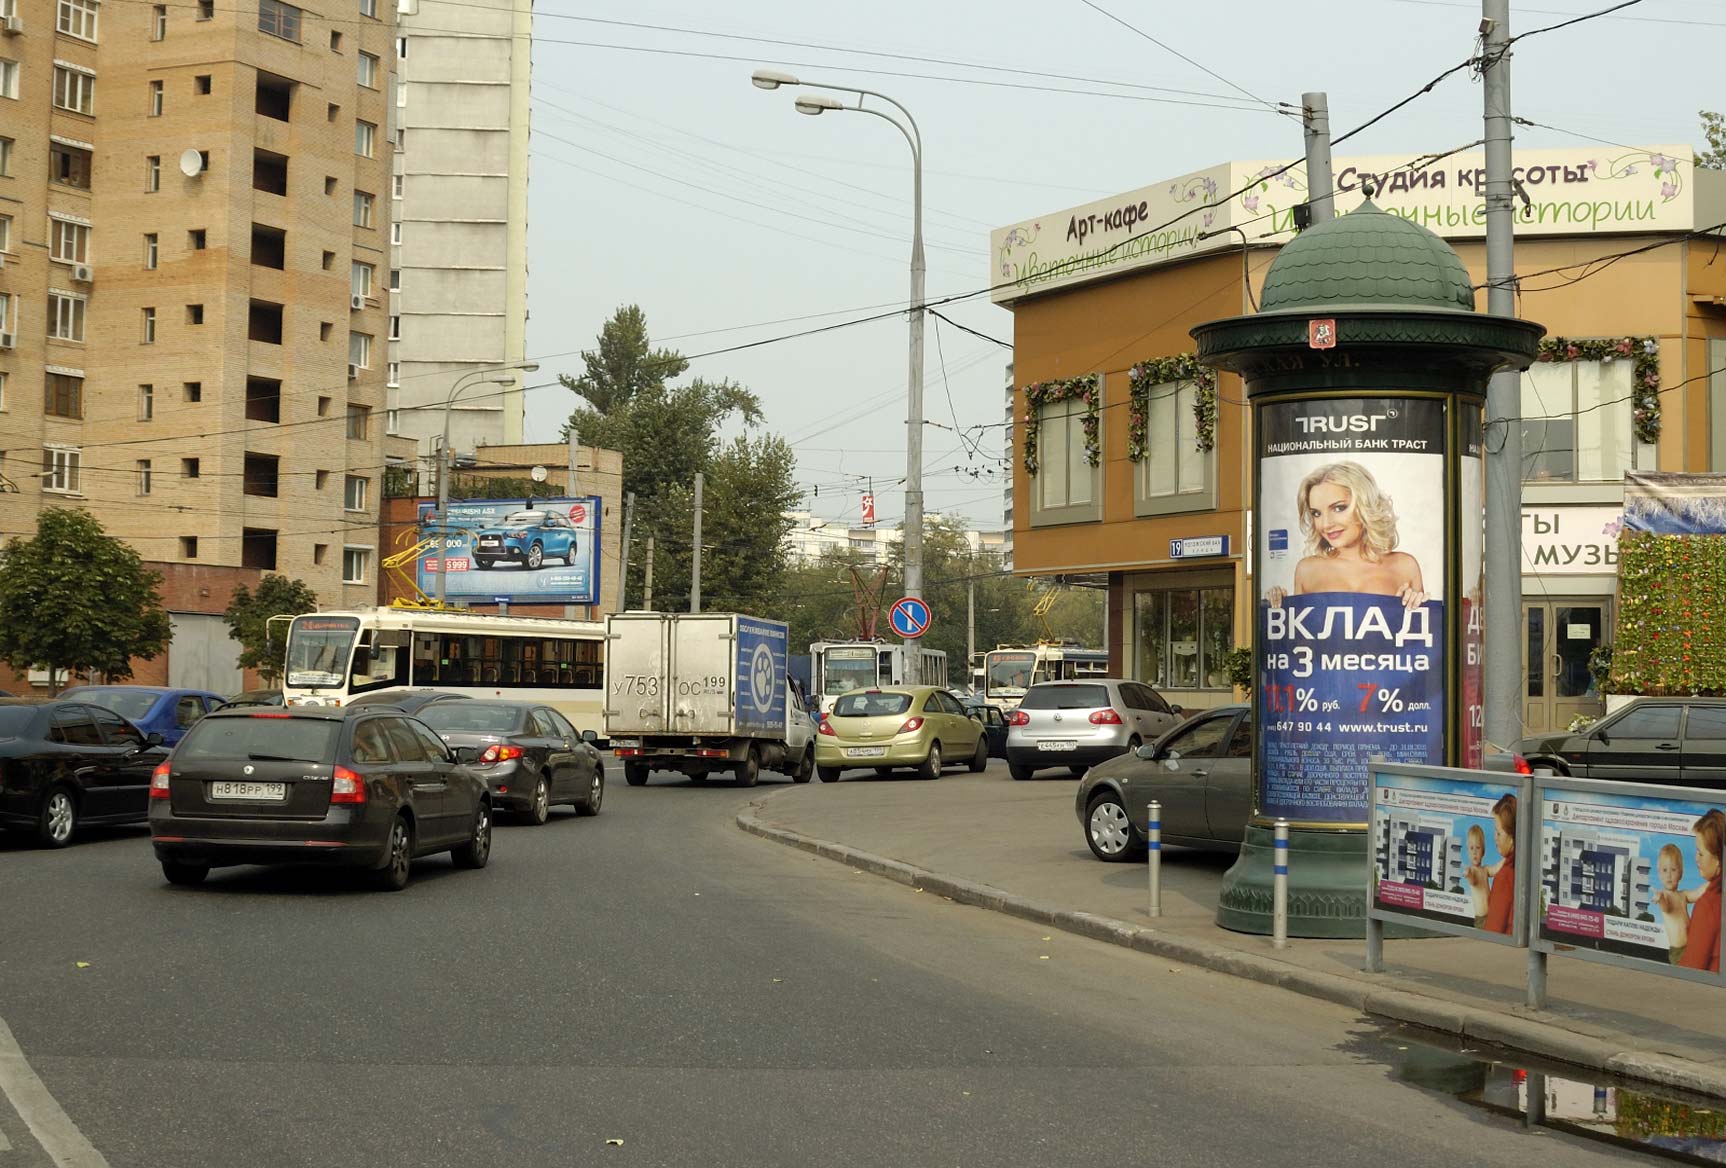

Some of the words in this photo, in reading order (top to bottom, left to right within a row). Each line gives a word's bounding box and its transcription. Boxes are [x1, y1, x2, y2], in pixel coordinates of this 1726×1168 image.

[1337, 167, 1446, 198] Студия
[1458, 163, 1589, 192] крсоты
[1066, 200, 1149, 246] Арт-кафе
[1013, 244, 1119, 296] Цветочные
[1121, 224, 1200, 258] истории
[1295, 415, 1386, 433] TRUST
[1267, 437, 1352, 453] НАЦИОНАЛЬНЫЙ
[1355, 439, 1389, 450] БАНК
[1391, 440, 1428, 450] ТРАСТ
[1172, 541, 1182, 556] 19
[1267, 606, 1433, 647] ВКЛАД
[1267, 653, 1290, 670] на
[1292, 646, 1313, 678] 3
[1321, 653, 1430, 673] месяца
[703, 676, 726, 687] 199
[1322, 701, 1341, 713] руб.
[1408, 702, 1431, 711] долл.
[1276, 721, 1294, 732] 647
[1297, 721, 1313, 732] 90
[1316, 722, 1332, 732] 44
[1338, 721, 1428, 733] www.trust.ru
[266, 784, 282, 793] 199
